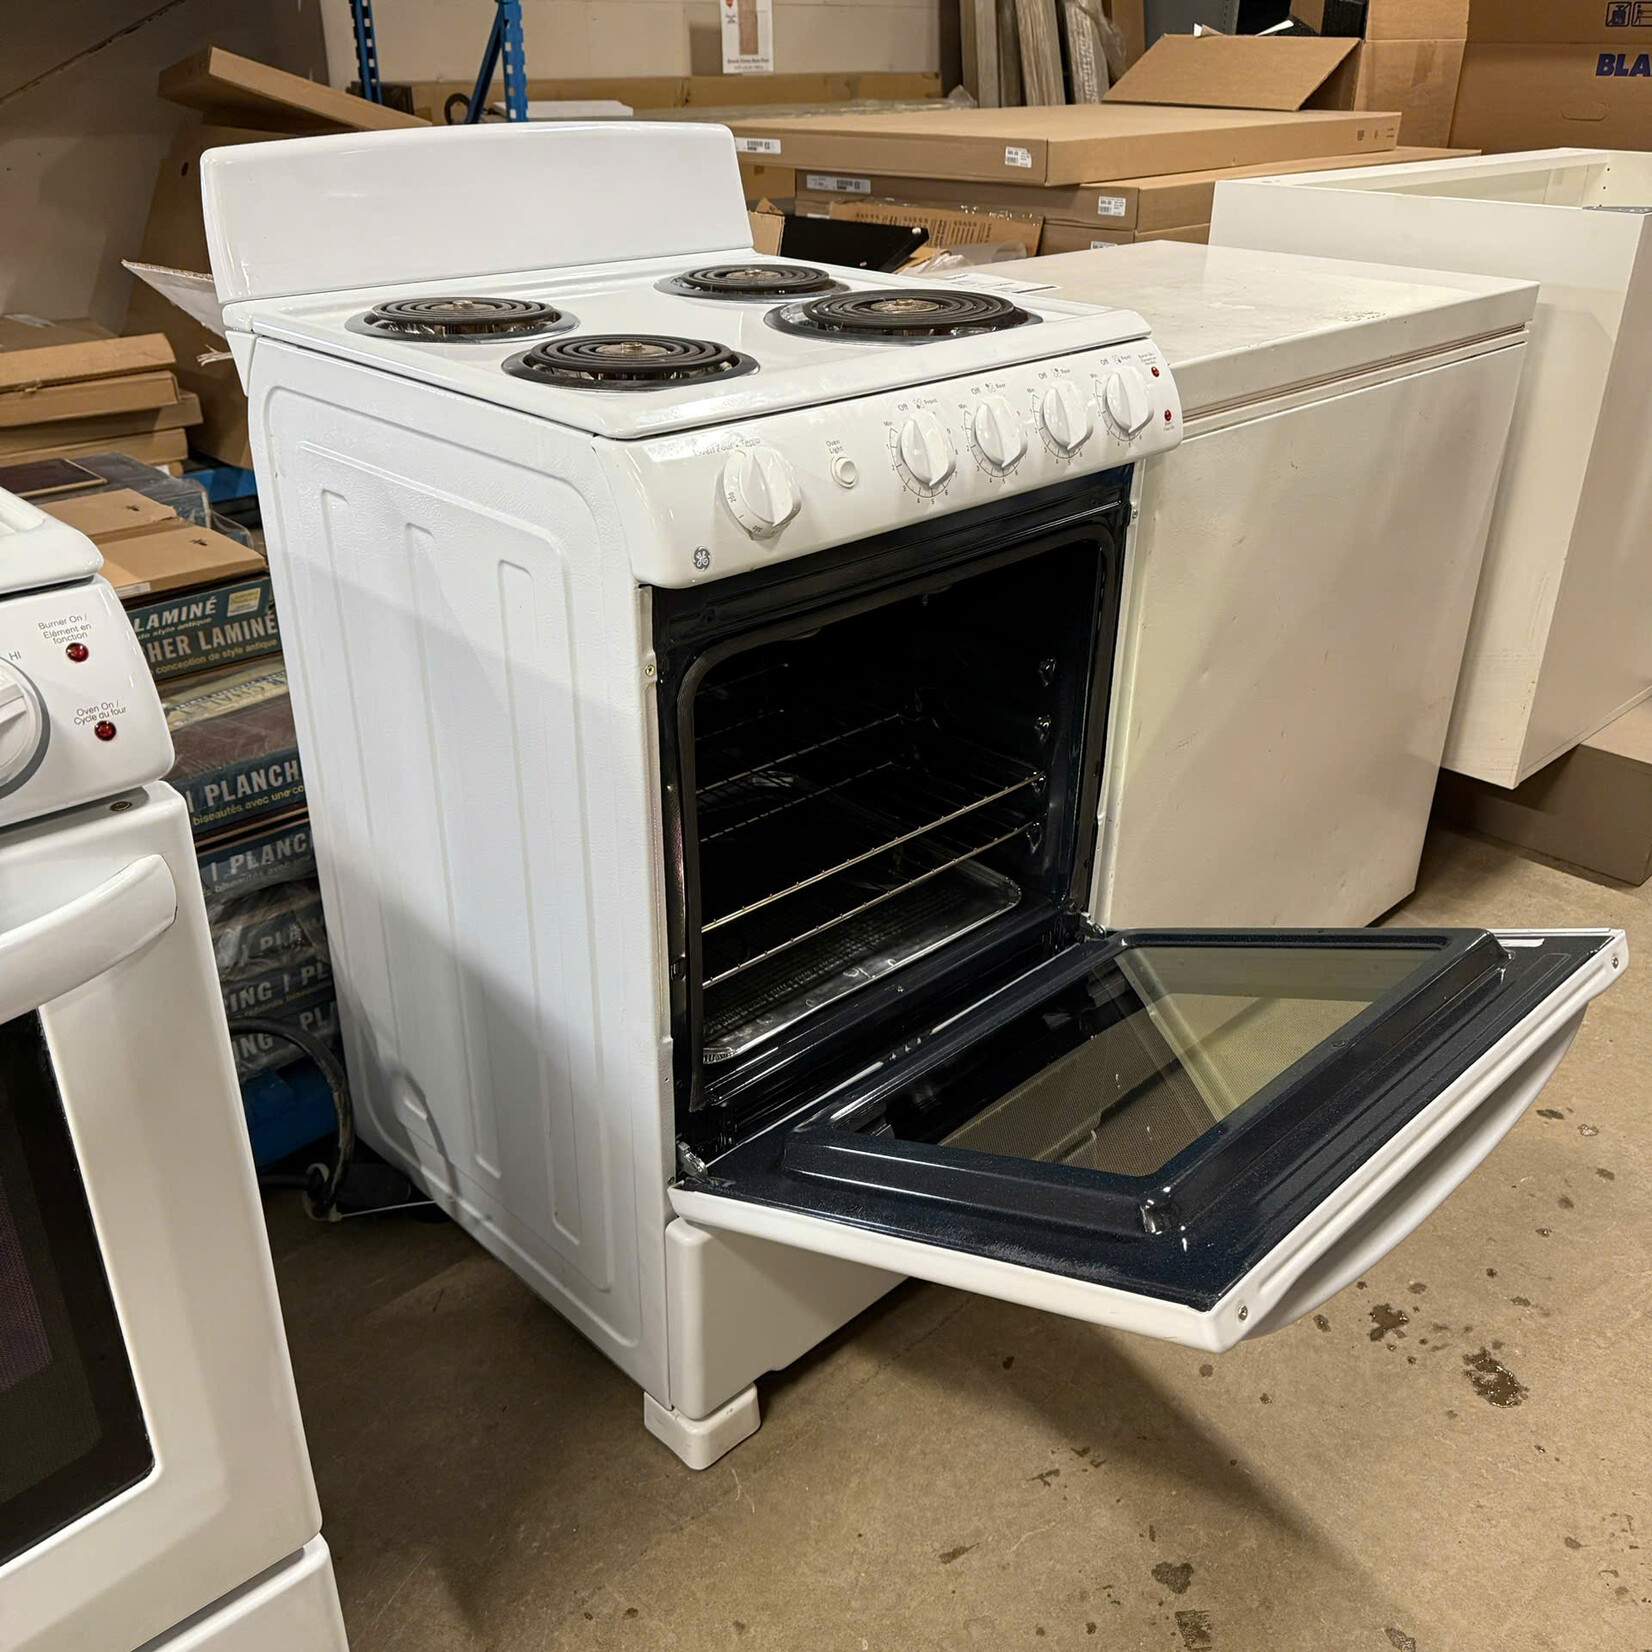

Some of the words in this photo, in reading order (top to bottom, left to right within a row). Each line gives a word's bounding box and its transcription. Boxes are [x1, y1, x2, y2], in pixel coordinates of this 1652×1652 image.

[1595, 53, 1652, 78] BLA
[37, 616, 67, 630] Burner
[69, 614, 83, 623] On
[133, 595, 218, 633] LAMINÉ
[52, 631, 89, 645] fonction
[80, 623, 92, 632] en
[197, 609, 278, 651] LAMINÉ
[8, 651, 21, 661] HI
[154, 654, 207, 674] conception
[208, 650, 221, 661] de
[222, 644, 245, 660] style
[245, 638, 278, 653] antique
[73, 711, 99, 727] Cycle
[98, 709, 111, 719] du
[110, 706, 127, 717] four
[76, 705, 100, 718] Oven
[100, 701, 115, 711] On
[203, 759, 299, 808] PLANCH
[191, 803, 243, 826] biseautés
[244, 795, 270, 810] avec
[271, 787, 291, 802] une
